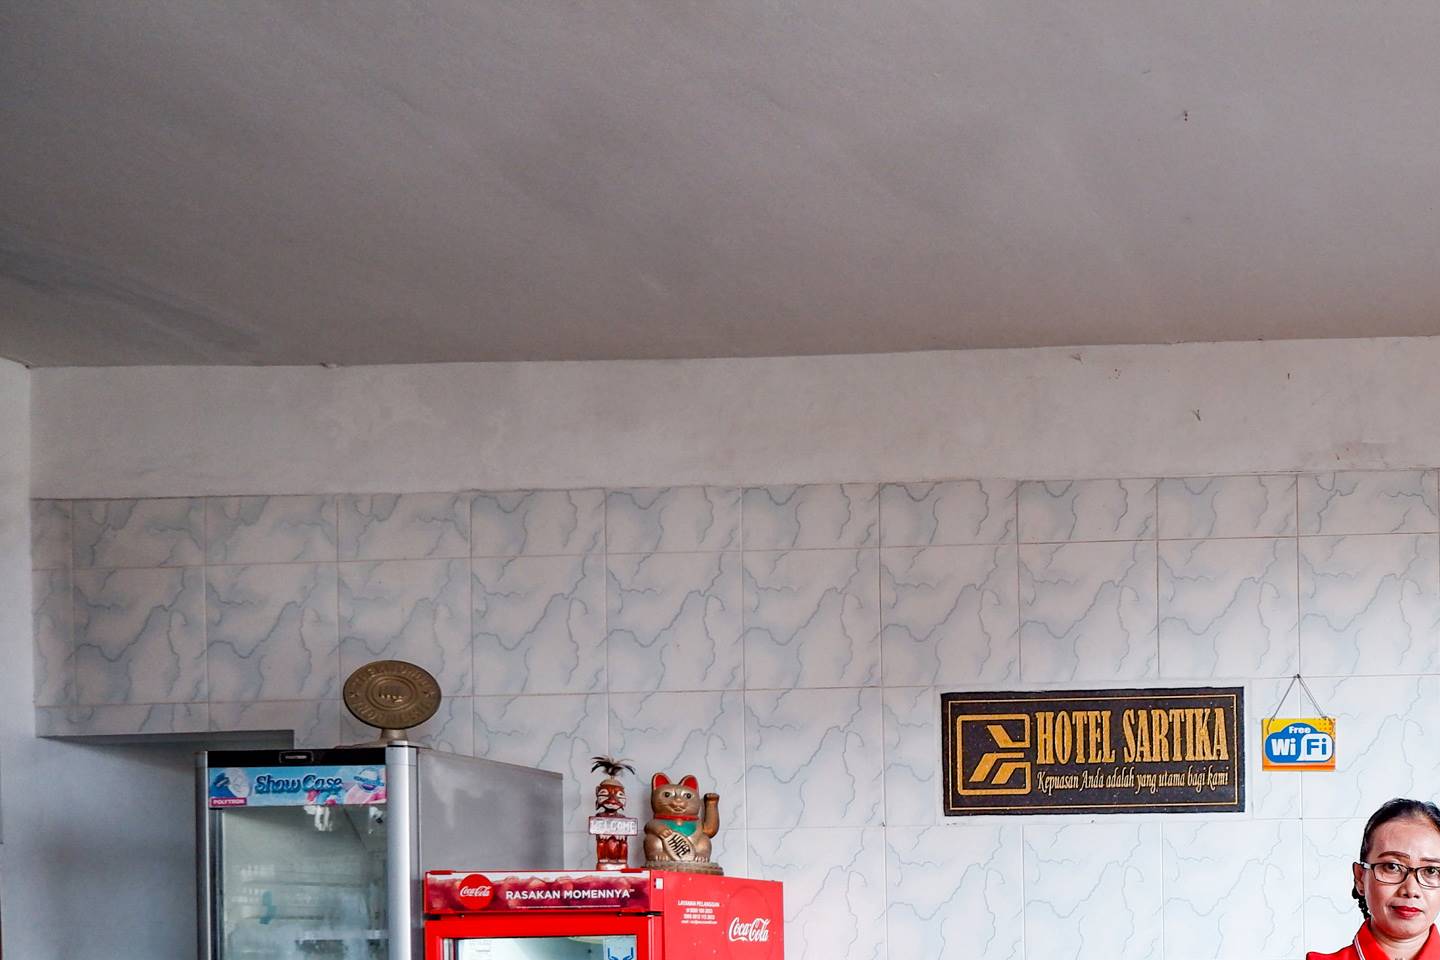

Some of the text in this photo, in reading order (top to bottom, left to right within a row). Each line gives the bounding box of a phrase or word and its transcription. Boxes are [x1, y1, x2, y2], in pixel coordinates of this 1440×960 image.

[1035, 707, 1229, 765] HOTEL SARTIKA
[1288, 726, 1311, 734] Free
[1036, 765, 1229, 796] Kepuasan Anda adalah yang utama bagi kami
[505, 890, 561, 900] RASAKAN
